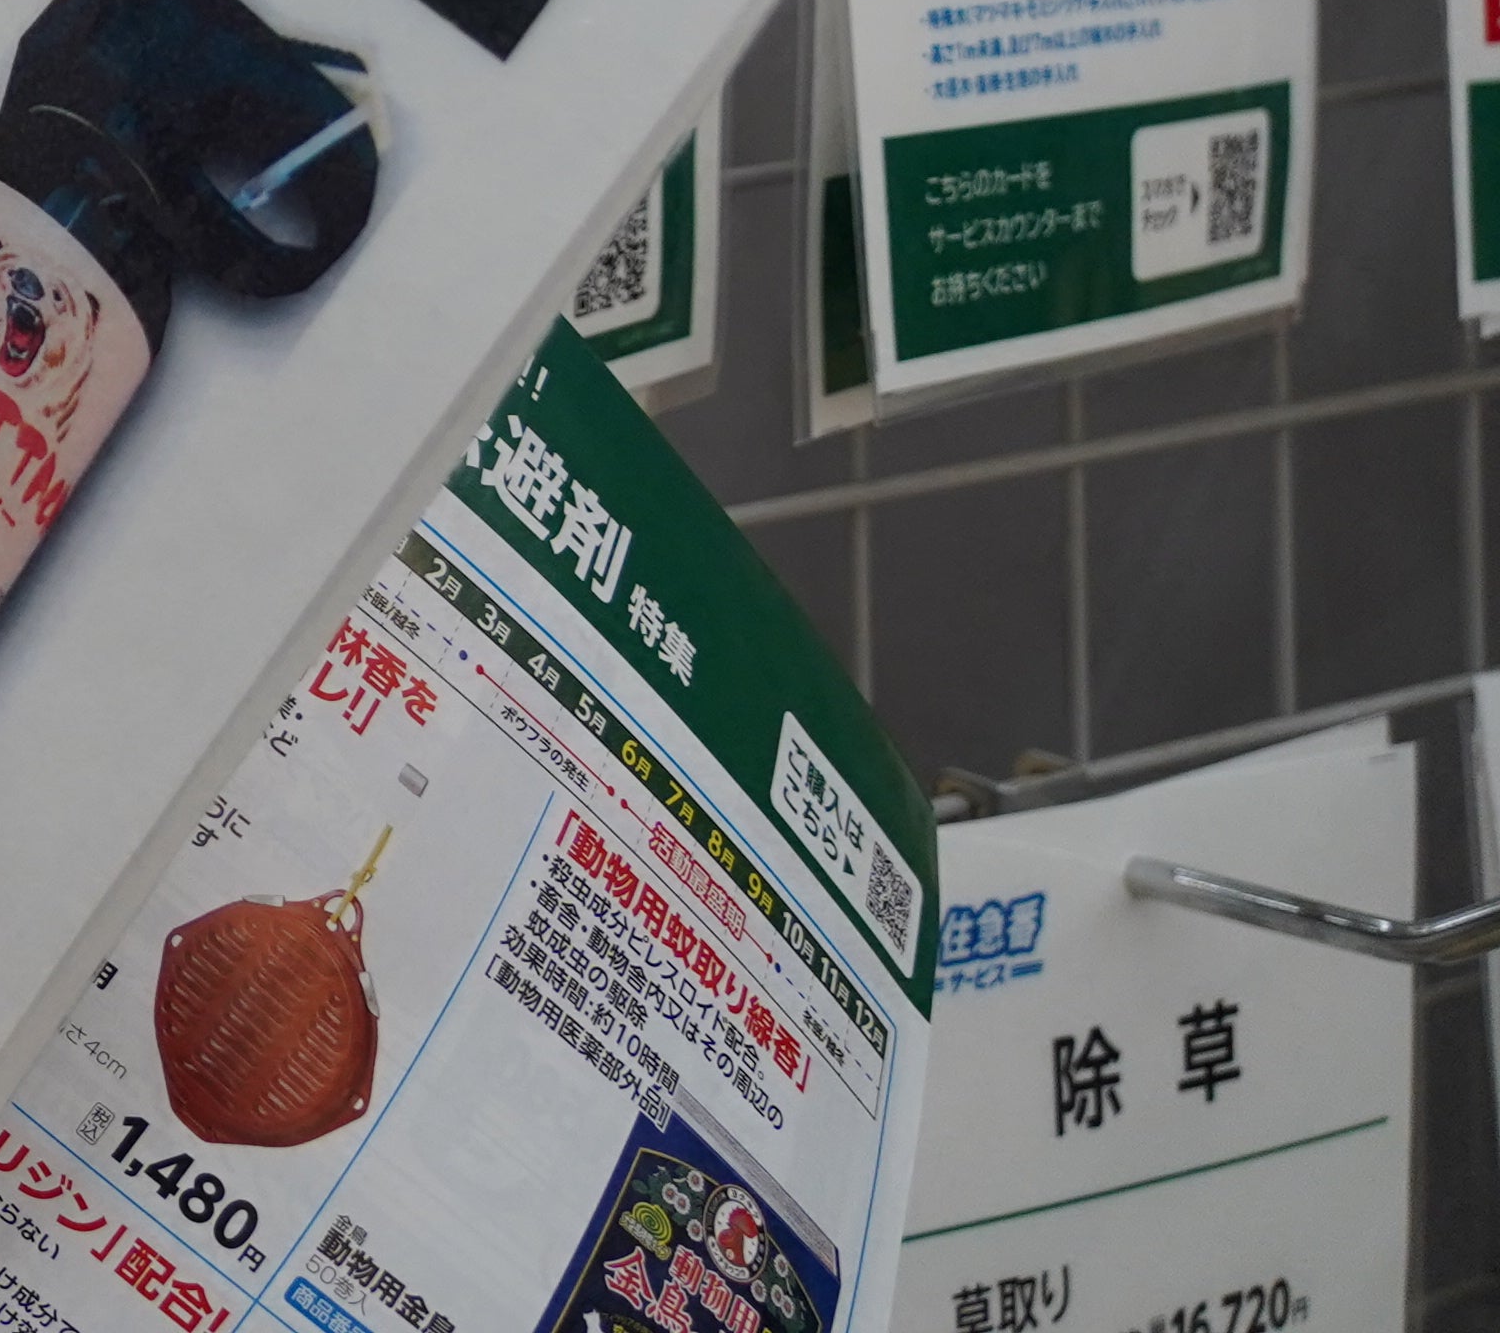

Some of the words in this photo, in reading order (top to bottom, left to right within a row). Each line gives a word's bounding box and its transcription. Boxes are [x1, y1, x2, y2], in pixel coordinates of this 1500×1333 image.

[465, 415, 632, 605] 避剤
[626, 583, 700, 687] 特集
[423, 555, 463, 603] 2月
[475, 603, 513, 645] 3月
[526, 652, 562, 693] 4月
[573, 691, 608, 736] 5月
[621, 738, 655, 782] 6月
[664, 786, 696, 827] 7月
[707, 830, 738, 874] 8月
[746, 874, 776, 917] 9月
[780, 910, 818, 964] 10月
[818, 955, 852, 1007] 11月
[851, 996, 889, 1056] 12月
[499, 704, 593, 795] ボウフラの発生
[787, 737, 866, 851] ご購入は
[647, 831, 747, 942] 活動最盛期
[937, 890, 1046, 969] 住急番
[526, 910, 650, 1035] 蚊成虫の駆除
[555, 808, 815, 1095] 「動物用蚊取り線香」
